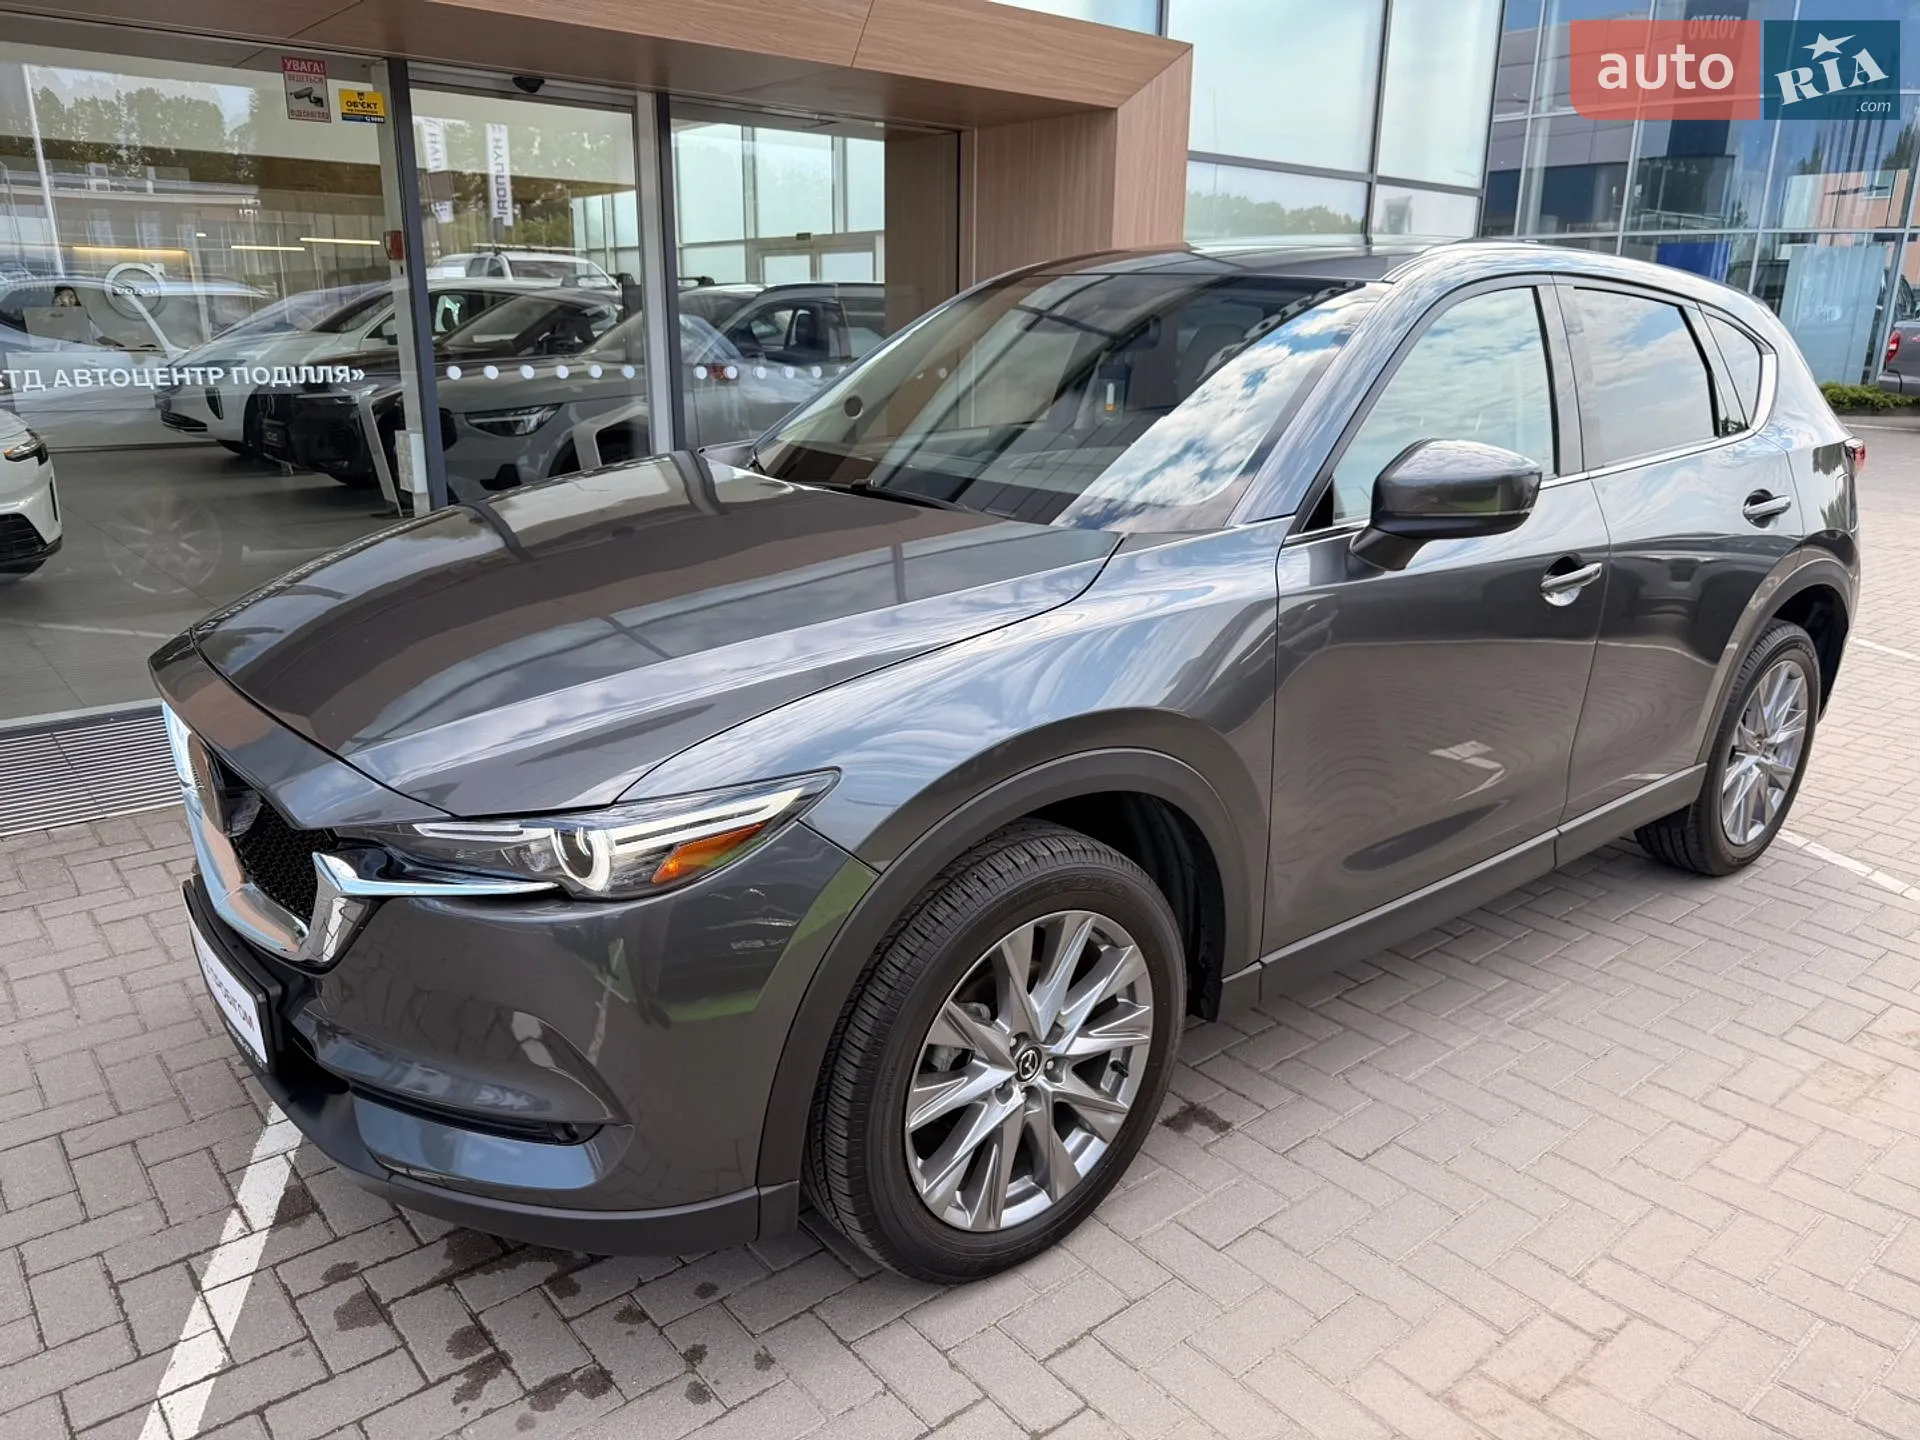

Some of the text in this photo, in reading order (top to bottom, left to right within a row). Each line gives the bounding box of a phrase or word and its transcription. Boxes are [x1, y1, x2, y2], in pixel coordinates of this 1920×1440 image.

[284, 59, 324, 74] УВАГА!
[0, 365, 366, 392] ТД АВТОЦЕНТР ПОДІЛЛЯ»
